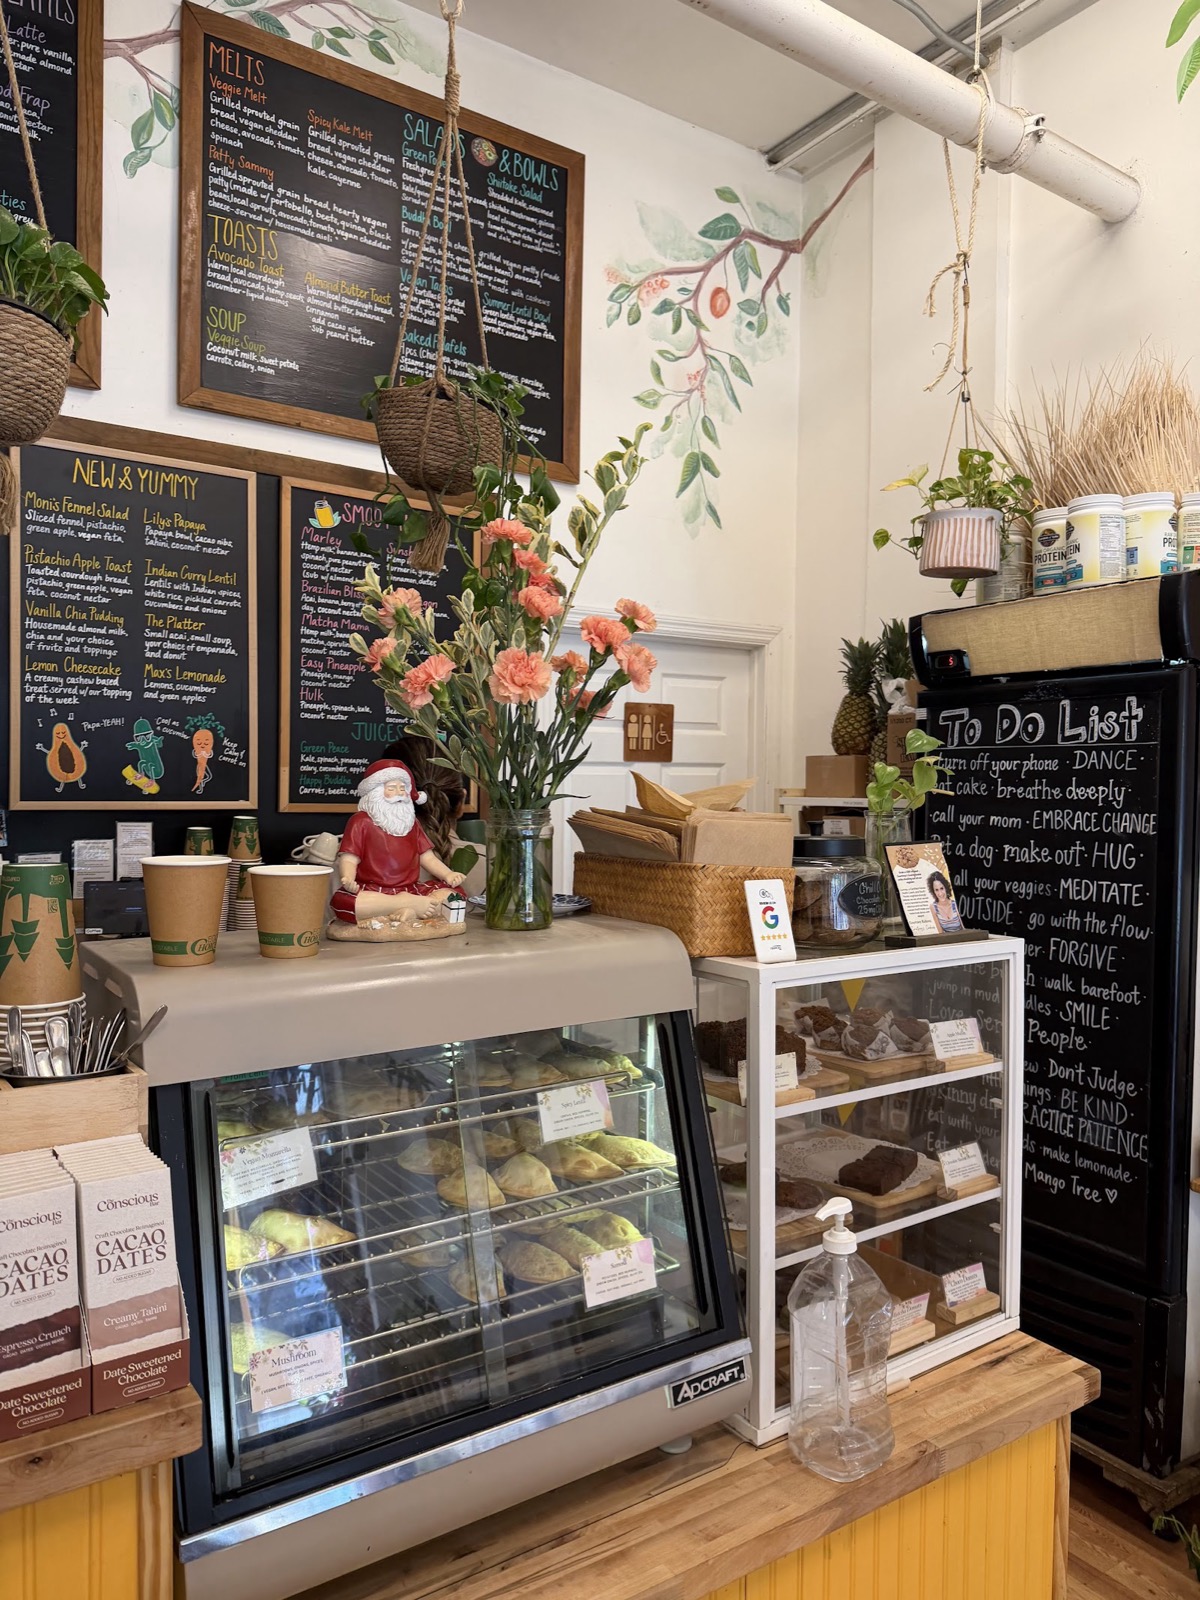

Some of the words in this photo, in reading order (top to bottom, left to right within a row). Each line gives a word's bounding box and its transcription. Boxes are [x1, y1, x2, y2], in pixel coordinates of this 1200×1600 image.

[7, 16, 47, 43] Latte
[209, 42, 265, 86] MELTS
[20, 86, 51, 116] Frap
[209, 73, 241, 98] Veggie
[244, 87, 267, 104] Melt
[210, 91, 241, 111] Grilled
[242, 105, 275, 123] sprouted
[277, 118, 300, 132] grain
[210, 104, 237, 124] bread,
[239, 116, 264, 131] vegan
[265, 124, 298, 142] cheddar
[307, 109, 332, 133] Spicy
[333, 117, 351, 134] Kale
[352, 125, 373, 142] Melt
[209, 145, 234, 169] Patty
[238, 156, 274, 181] Sammy
[402, 141, 428, 162] Green
[499, 149, 510, 173] &
[514, 153, 559, 191] BOWLS
[207, 214, 278, 261] TOASTS
[207, 244, 255, 269] Avocado
[258, 256, 284, 277] Toast
[305, 272, 339, 292] Almond
[341, 281, 370, 298] Butter
[370, 287, 391, 305] Toast
[207, 307, 246, 333] SOUP
[482, 292, 511, 312] Summer
[511, 302, 532, 318] Lentil
[534, 310, 551, 323] Bowl
[208, 328, 240, 347] Veggie
[241, 336, 265, 354] Soup
[73, 458, 116, 489] NEW
[118, 466, 132, 491] &
[137, 468, 199, 500] YUMMY
[25, 491, 60, 512] Moni's
[62, 496, 96, 516] Fennel
[97, 503, 129, 520] Salad
[144, 508, 172, 530] Lily's
[174, 513, 207, 536] Papaya
[301, 526, 342, 548] Marley
[24, 544, 70, 567] Pistachio
[72, 553, 101, 572] Apple
[104, 556, 132, 574] Toast
[1034, 551, 1066, 564] PROTEIN
[144, 559, 178, 578] Indian
[180, 565, 207, 586] Curry
[208, 570, 237, 586] Lentil
[301, 580, 342, 597] Brazilian
[344, 585, 365, 600] Bliss
[24, 618, 76, 632] Housemade
[78, 625, 107, 635] almond
[108, 628, 128, 636] milk,
[25, 600, 62, 618] Vanilla
[65, 605, 87, 620] Chia
[89, 606, 124, 628] Pudding
[145, 614, 164, 627] The
[167, 615, 206, 631] Platter
[301, 614, 339, 629] Matcha
[341, 620, 370, 632] Mama
[25, 655, 58, 672] Lemon
[64, 656, 122, 676] Cheesecake
[144, 664, 172, 679] Max's
[176, 666, 227, 684] Lemonade
[301, 655, 324, 671] Easy
[326, 657, 366, 674] Pineapple
[144, 679, 175, 691] Lemons,
[176, 684, 217, 694] cucumbers
[300, 687, 324, 702] Hulk
[351, 722, 404, 742] JUICES
[939, 707, 981, 747] To
[996, 704, 1044, 744] Do
[1058, 696, 1143, 744] List
[300, 741, 326, 754] Green
[328, 742, 349, 754] Peace
[938, 751, 967, 770] turn
[970, 753, 989, 770] off
[990, 760, 1021, 778] your
[1022, 753, 1059, 778] phone
[1073, 750, 1137, 770] DANCE
[299, 775, 322, 789] Happy
[323, 774, 352, 785] Buddha
[956, 777, 988, 795] cake
[997, 779, 1062, 799] breathe
[1066, 777, 1125, 809] deeply
[932, 805, 954, 823] call
[959, 813, 985, 831] your
[989, 815, 1021, 829] mom
[1033, 810, 1100, 831] EMBRACE
[1102, 812, 1157, 835] CHANGE
[955, 842, 965, 856] a
[969, 834, 993, 867] dog
[1003, 840, 1052, 863] make
[1055, 841, 1085, 866] out
[1092, 841, 1136, 869] HUG
[954, 869, 968, 887] all
[974, 876, 1004, 895] your
[1005, 878, 1051, 900] veggies
[1059, 878, 1143, 907] MEDITATE
[959, 894, 1014, 925] OUTSIDE
[1027, 912, 1045, 931] go
[1050, 910, 1080, 931] with
[1084, 912, 1107, 935] the
[1111, 914, 1152, 940] flow
[1049, 938, 1118, 972] FORGIVE
[1044, 974, 1075, 992] walk
[1081, 981, 1141, 1006] barefoot
[1060, 1000, 1111, 1030] SMILE
[1028, 1018, 1088, 1054] People
[1048, 1058, 1084, 1086] Don't
[1087, 1066, 1137, 1100] Judge
[1061, 1088, 1078, 1112] BE
[1084, 1093, 1128, 1125] KIND
[1078, 1118, 1148, 1162] PATIENCE
[1042, 1146, 1070, 1164] make
[1075, 1150, 1133, 1183] lemonade
[1025, 1162, 1065, 1194] Mango
[1071, 1175, 1102, 1203] Tree
[97, 1192, 159, 1212] Conscious
[95, 1231, 108, 1240] Craft
[110, 1227, 135, 1236] Chocolate
[136, 1220, 165, 1231] Reimagined
[96, 1228, 166, 1257] CACAO
[97, 1245, 167, 1276] DATES
[103, 1310, 139, 1327] Creamy
[140, 1303, 167, 1316] Tahini
[38, 1325, 71, 1342] Crunch
[103, 1366, 126, 1380] Date
[128, 1349, 182, 1372] Sweetened
[271, 1349, 317, 1367] Mushroom
[118, 1364, 168, 1385] Chocolate
[677, 1366, 739, 1402] ADCRAFT
[22, 1378, 82, 1404] Sweetened
[12, 1394, 67, 1418] Chocolate
